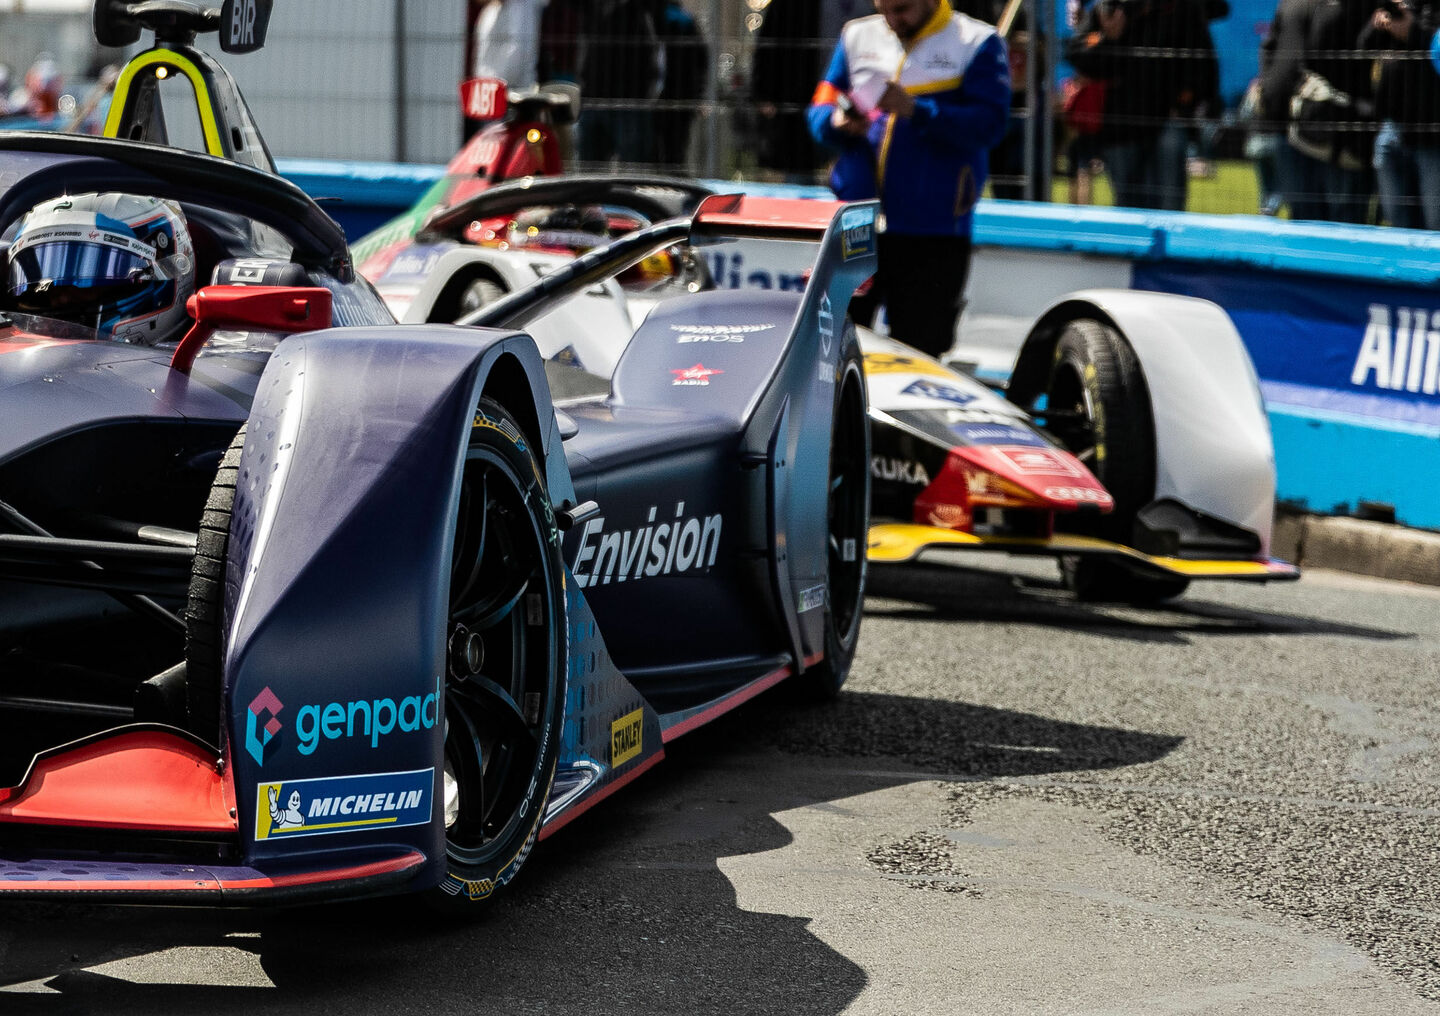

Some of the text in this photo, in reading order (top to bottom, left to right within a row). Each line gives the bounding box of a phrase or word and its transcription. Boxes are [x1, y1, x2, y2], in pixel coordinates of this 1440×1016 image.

[470, 82, 499, 116] ABT
[1351, 304, 1440, 396] Alli
[572, 501, 723, 588] Envision
[295, 676, 440, 756] genpact
[613, 719, 642, 758] STANLEY
[308, 789, 423, 818] MICHELIN
